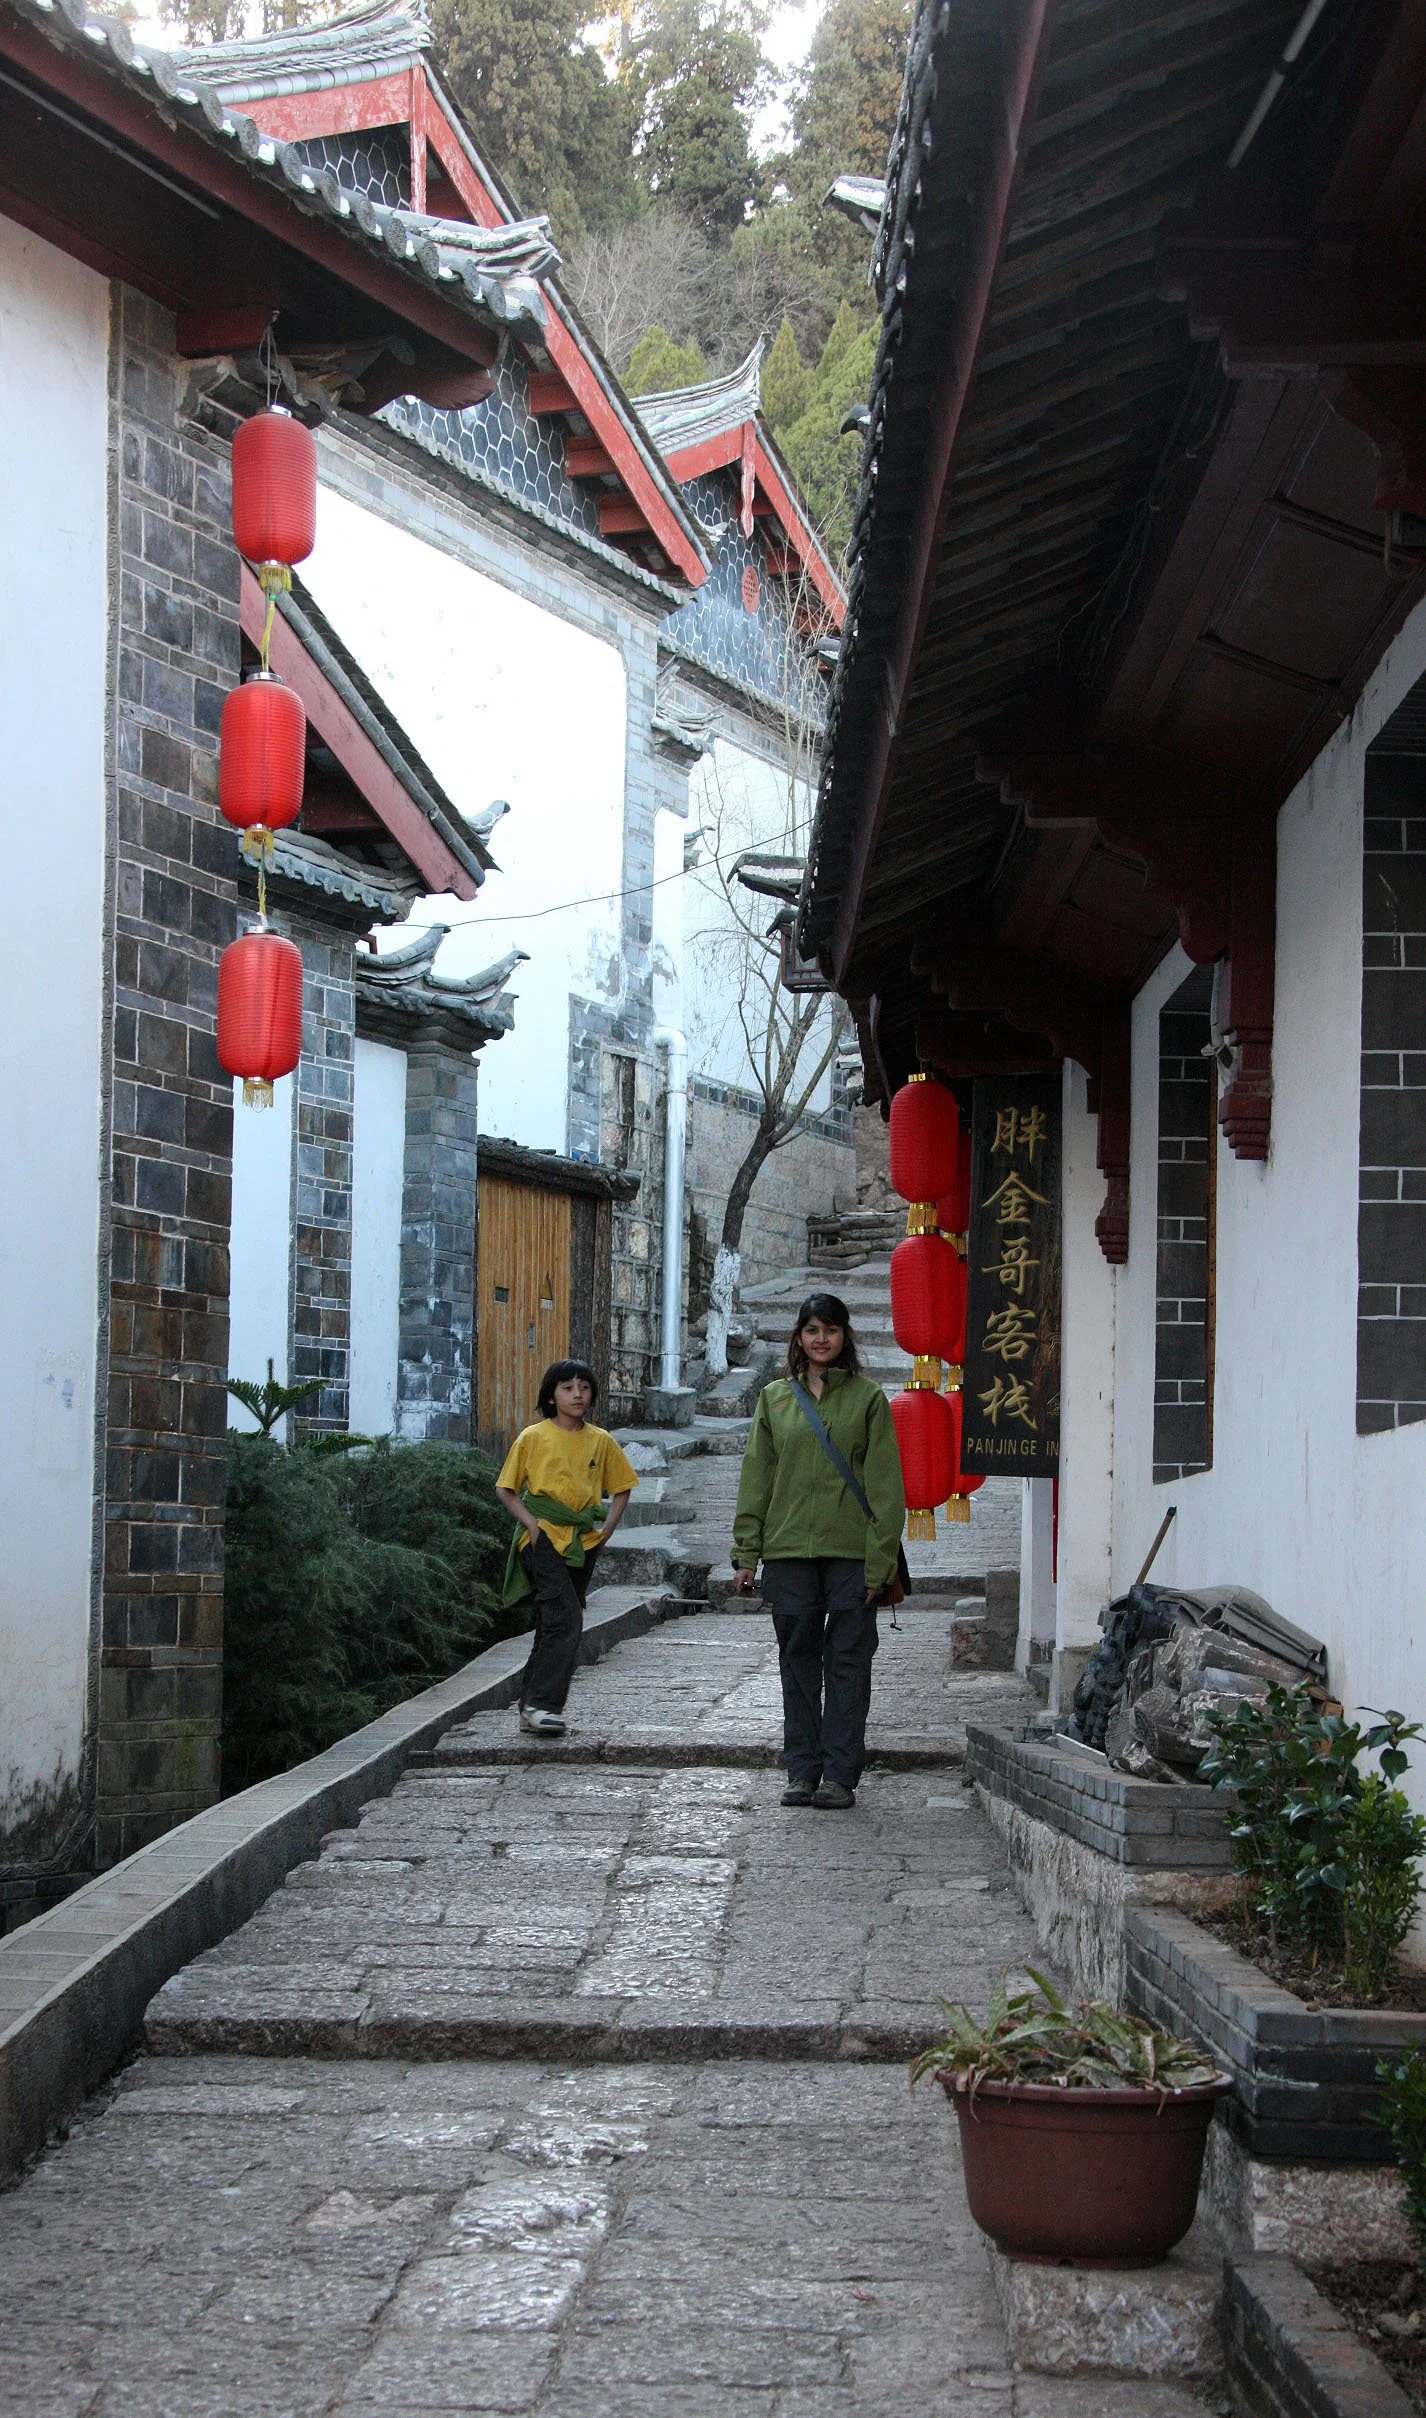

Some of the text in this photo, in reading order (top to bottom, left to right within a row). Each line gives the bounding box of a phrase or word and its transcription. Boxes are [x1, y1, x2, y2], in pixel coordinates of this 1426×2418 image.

[977, 1104, 1051, 1431] 胖金哥客栈
